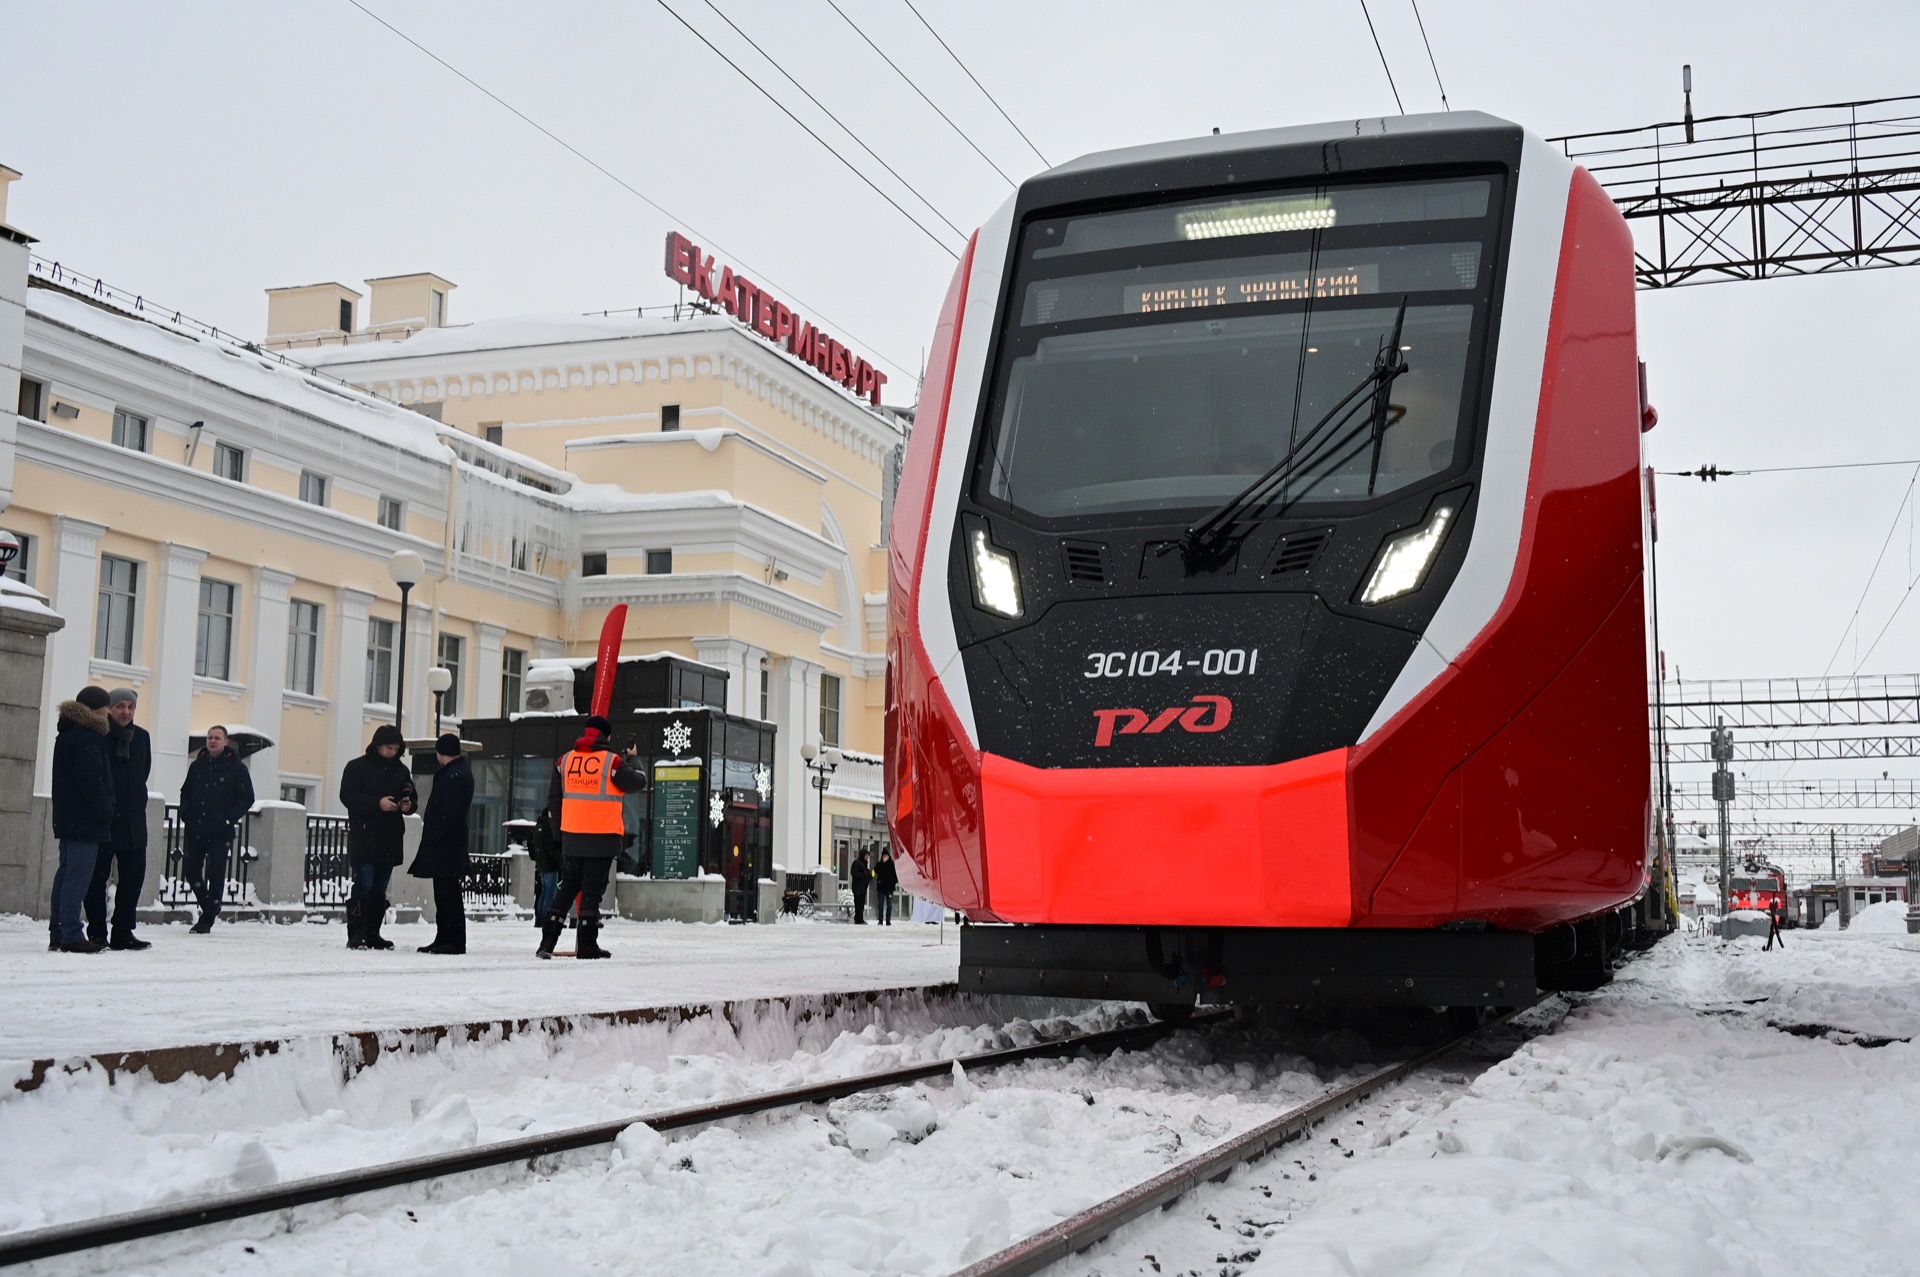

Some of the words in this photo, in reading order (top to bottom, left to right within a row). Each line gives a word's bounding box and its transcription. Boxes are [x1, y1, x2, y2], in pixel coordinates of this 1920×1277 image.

[664, 231, 888, 406] ЕКАТЕРИНБУРГ
[1084, 649, 1258, 678] ЭС104-001
[567, 756, 600, 778] ДС
[567, 778, 598, 786] СТАНЦИЯ
